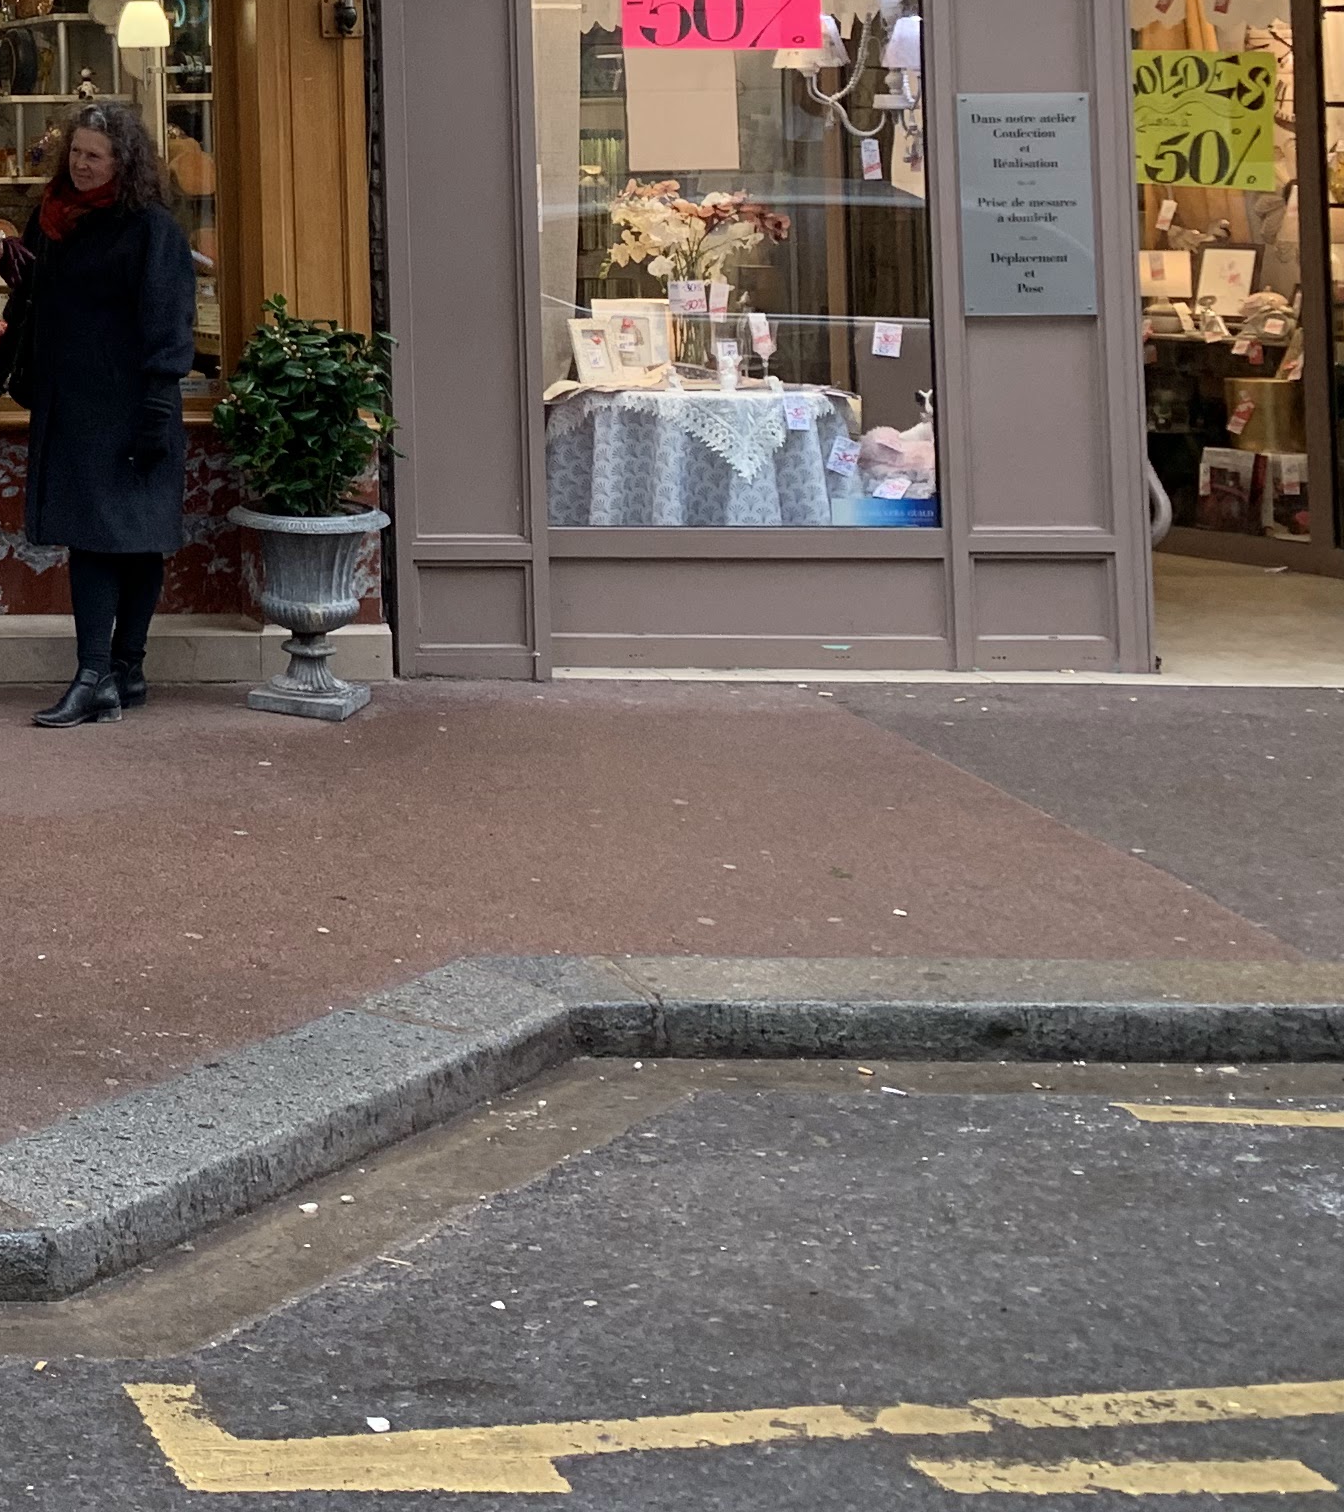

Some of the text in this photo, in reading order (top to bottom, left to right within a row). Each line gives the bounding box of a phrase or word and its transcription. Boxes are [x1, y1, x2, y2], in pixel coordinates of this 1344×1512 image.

[1132, 54, 1272, 111] OLDES
[970, 113, 1076, 124] Dans notre atelier
[992, 128, 1056, 139] Confection
[1019, 144, 1030, 153] et
[1135, 125, 1261, 185] -50%
[977, 197, 1077, 208] Prise de mesures
[1007, 212, 1059, 223] domicile
[1024, 269, 1035, 278] et
[1017, 283, 1044, 294] Pose
